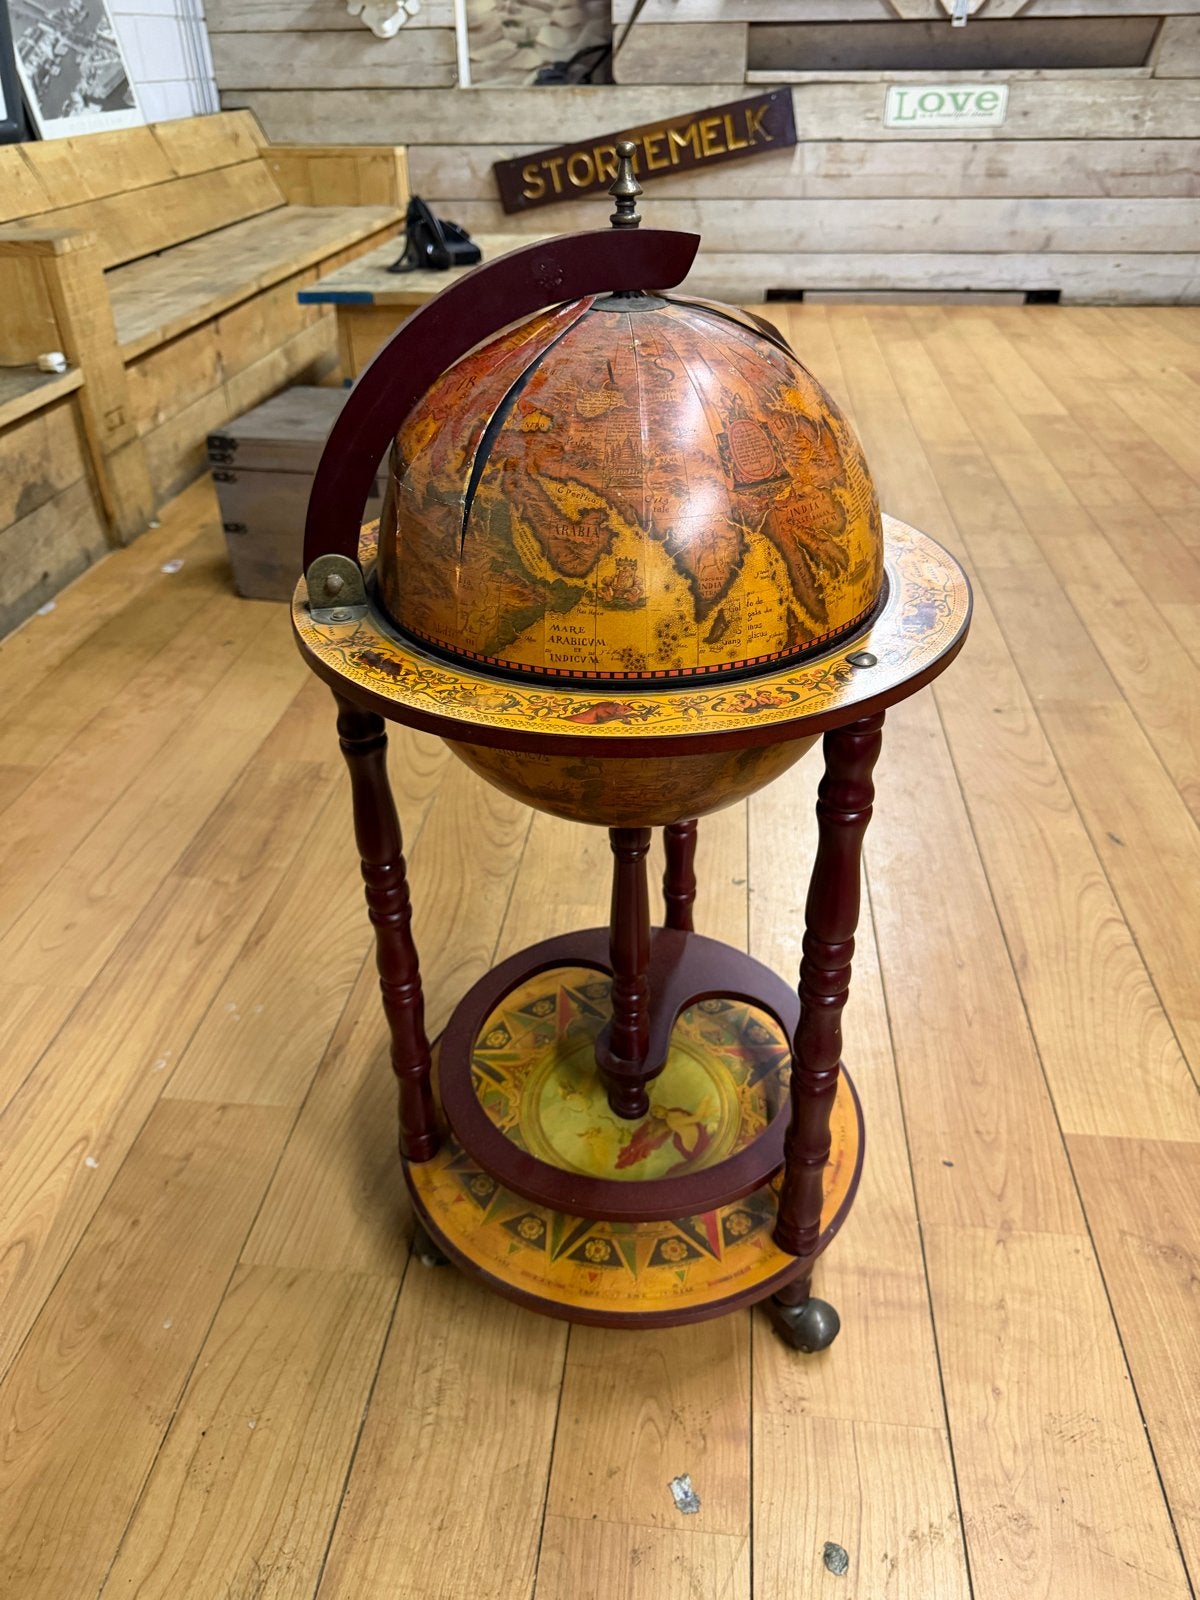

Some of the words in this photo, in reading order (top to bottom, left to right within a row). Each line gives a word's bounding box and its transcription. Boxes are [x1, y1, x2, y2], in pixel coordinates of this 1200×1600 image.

[893, 91, 1000, 121] Love
[790, 502, 820, 518] INDIA
[554, 523, 600, 538] ARABIA
[550, 624, 586, 634] MARE
[547, 635, 606, 647] ARABICVM
[550, 653, 599, 664] INDICVM
